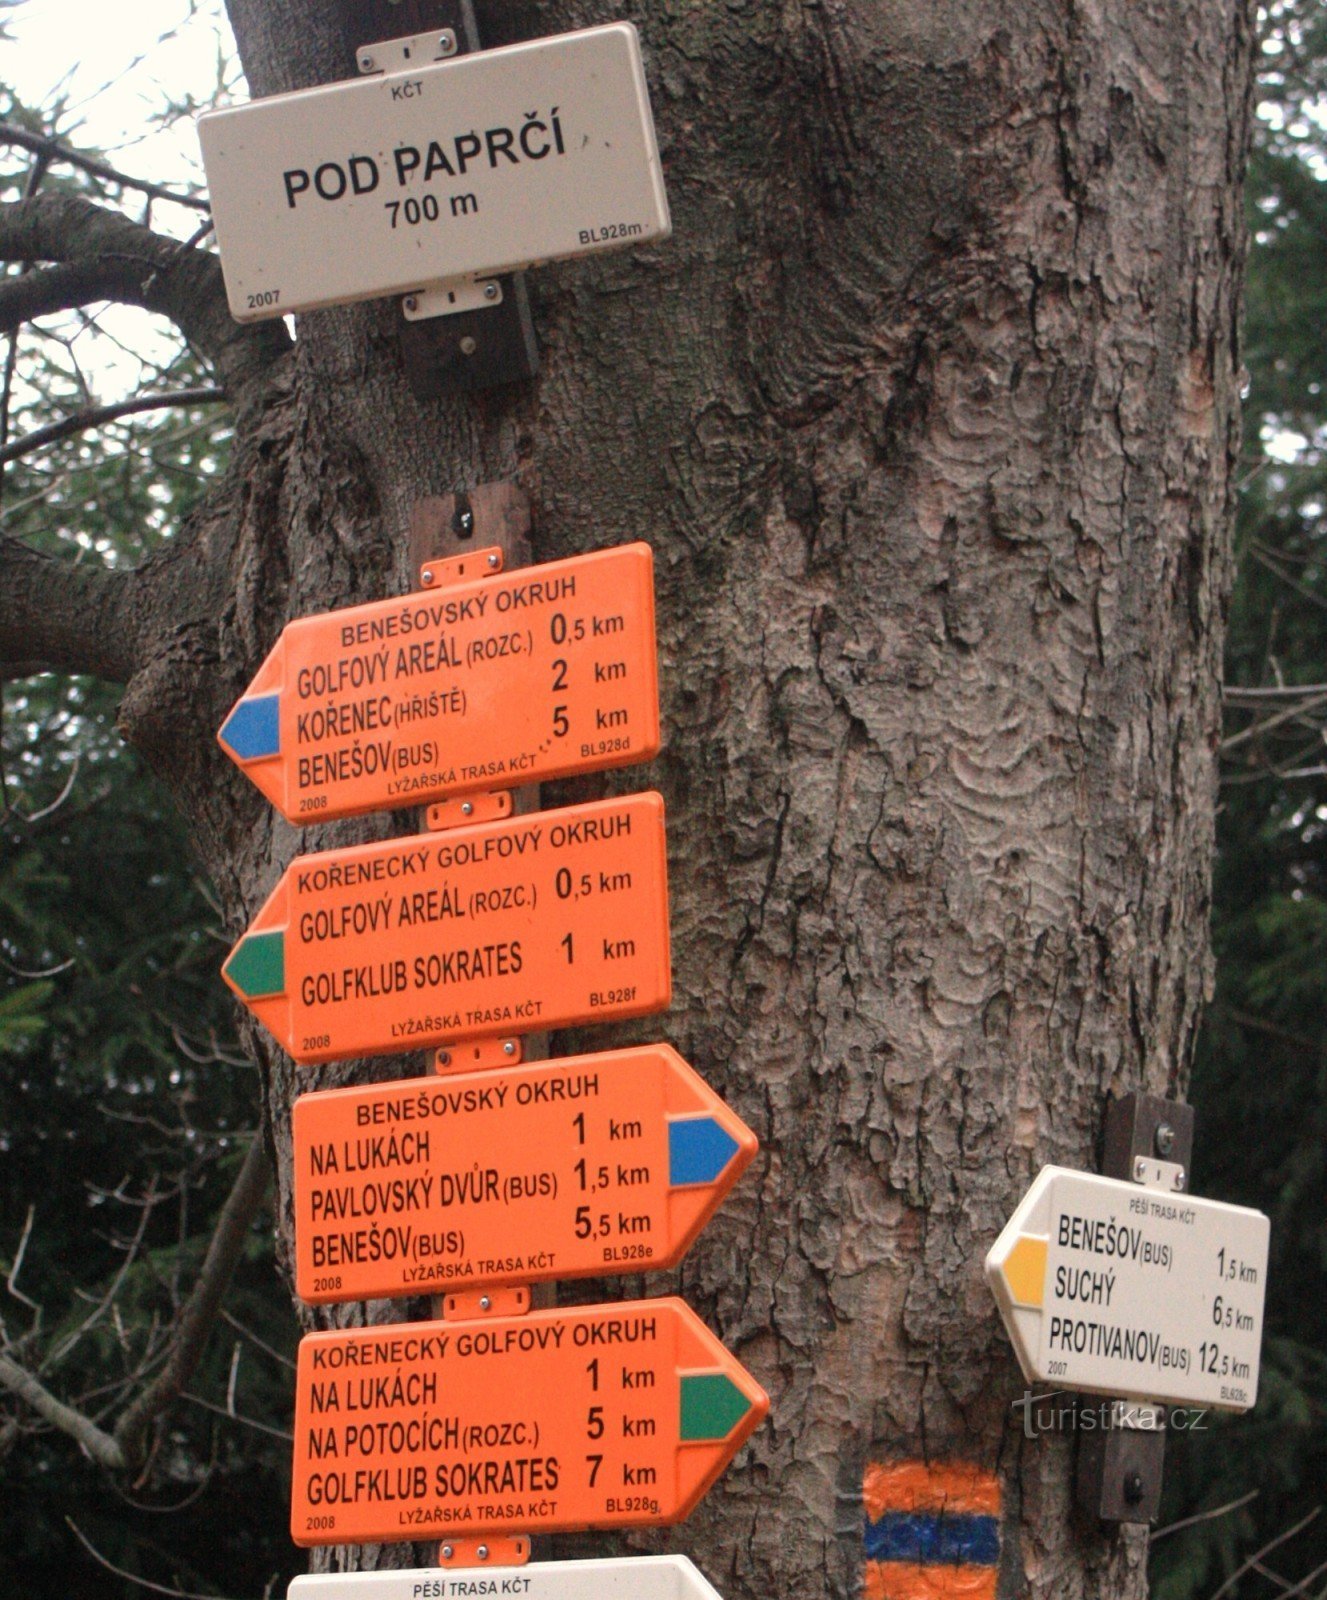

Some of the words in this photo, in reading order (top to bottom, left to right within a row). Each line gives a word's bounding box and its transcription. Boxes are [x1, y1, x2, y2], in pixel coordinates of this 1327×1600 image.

[391, 80, 424, 101] KČT
[283, 155, 379, 208] POD
[394, 107, 565, 186] PAPRČÍ
[385, 193, 439, 228] 700
[451, 191, 479, 216] m
[579, 222, 642, 245] BL928m
[247, 290, 280, 309] 2007
[341, 590, 488, 648] BENEŠOVSKÝ
[495, 575, 576, 612] OKRUH
[298, 643, 389, 699] GOLFOVÝ
[551, 613, 585, 647] 0,5
[593, 615, 624, 636] km
[552, 660, 568, 692] 2
[595, 660, 626, 682] km
[553, 706, 569, 737] 5
[596, 708, 628, 729] km
[581, 738, 630, 758] BL928d
[388, 766, 456, 796] LYŽAŘSKÁ
[461, 760, 505, 781] TRASA
[509, 753, 536, 773] KČT
[300, 796, 327, 811] 2008
[298, 846, 427, 893] KOŘENECKÝ
[438, 825, 542, 868] GOLFOVÝ
[550, 814, 630, 847] OKRUH
[301, 892, 393, 942] GOLFOVÝ
[555, 868, 591, 902] 0,5
[599, 871, 632, 892] km
[302, 960, 407, 1007] GOLFKLUB
[414, 941, 523, 988] SOKRATES
[561, 933, 574, 964] 1
[603, 938, 635, 959] km
[590, 988, 636, 1007] BL928f
[391, 1008, 461, 1037] LYŽAŘSKÁ
[466, 1005, 512, 1027] TRASA
[516, 999, 542, 1018] KČT
[302, 1035, 330, 1050] 2008
[356, 1085, 508, 1126] BENEŠOVSKÝ
[516, 1074, 599, 1105] OKRUH
[311, 1142, 339, 1176] NA
[345, 1127, 430, 1172] LUKÁCH
[573, 1112, 585, 1145] 1
[609, 1118, 642, 1140] km
[311, 1170, 432, 1221] PAVLOVSKÝ
[574, 1158, 609, 1193] 1,5
[617, 1164, 650, 1185] km
[574, 1206, 610, 1241] 5,5
[618, 1212, 651, 1233] km
[1150, 1203, 1178, 1220] TRASA
[1179, 1208, 1196, 1226] KČT
[403, 1257, 473, 1283] LYŽAŘSKÁ
[478, 1256, 523, 1276] TRASA
[528, 1253, 555, 1269] KČT
[603, 1245, 653, 1262] BL928e
[1218, 1248, 1236, 1282] 1,5
[1239, 1262, 1257, 1284] km
[314, 1278, 342, 1292] 2008
[1055, 1266, 1116, 1306] SUCHÝ
[1213, 1296, 1232, 1329] 6,5
[1235, 1310, 1254, 1331] km
[313, 1331, 450, 1370] KOŘENECKÝ
[457, 1320, 565, 1357] GOLFOVÝ
[573, 1318, 656, 1347] OKRUH
[1200, 1342, 1228, 1377] 12,5
[1232, 1358, 1249, 1379] km
[311, 1380, 341, 1413] NA
[347, 1366, 437, 1411] LUKÁCH
[586, 1358, 598, 1392] 1
[622, 1366, 655, 1389] km
[1048, 1360, 1067, 1376] 2007
[308, 1427, 339, 1460] NA
[587, 1406, 604, 1440] 5
[622, 1414, 655, 1437] km
[307, 1464, 426, 1506] GOLFKLUB
[435, 1456, 558, 1497] SOKRATES
[586, 1454, 603, 1489] 7
[623, 1462, 656, 1486] km
[399, 1502, 472, 1525] LYŽAŘSKÁ
[476, 1502, 524, 1519] TRASA
[528, 1500, 557, 1517] KČT
[605, 1496, 658, 1513] BL928g
[307, 1516, 335, 1530] 2008
[413, 1577, 445, 1598] PĚŠÍ
[450, 1581, 497, 1596] TRASA
[501, 1577, 530, 1594] KČT
